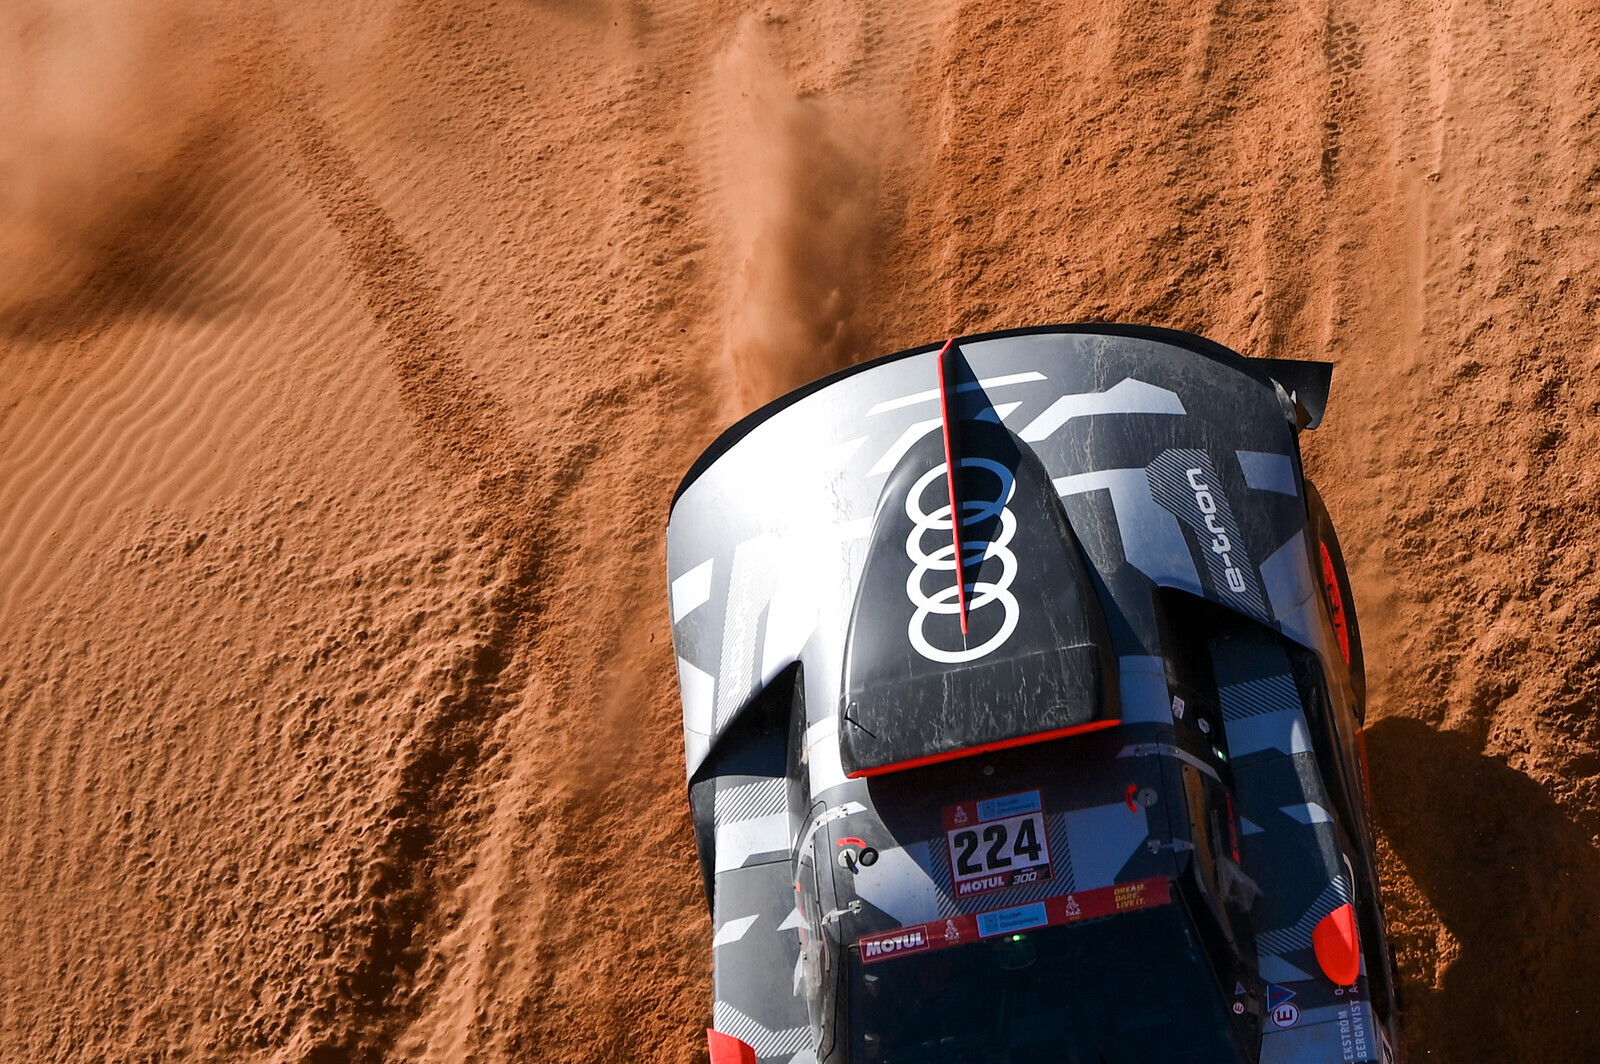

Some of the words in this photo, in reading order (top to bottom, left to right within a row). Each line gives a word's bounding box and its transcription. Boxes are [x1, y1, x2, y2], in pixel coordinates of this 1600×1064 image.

[1186, 467, 1246, 593] e-tron
[953, 817, 1042, 877] 224
[959, 876, 1005, 895] MOTUL
[866, 932, 925, 957] MOTUL
[1276, 1009, 1293, 1021] E
